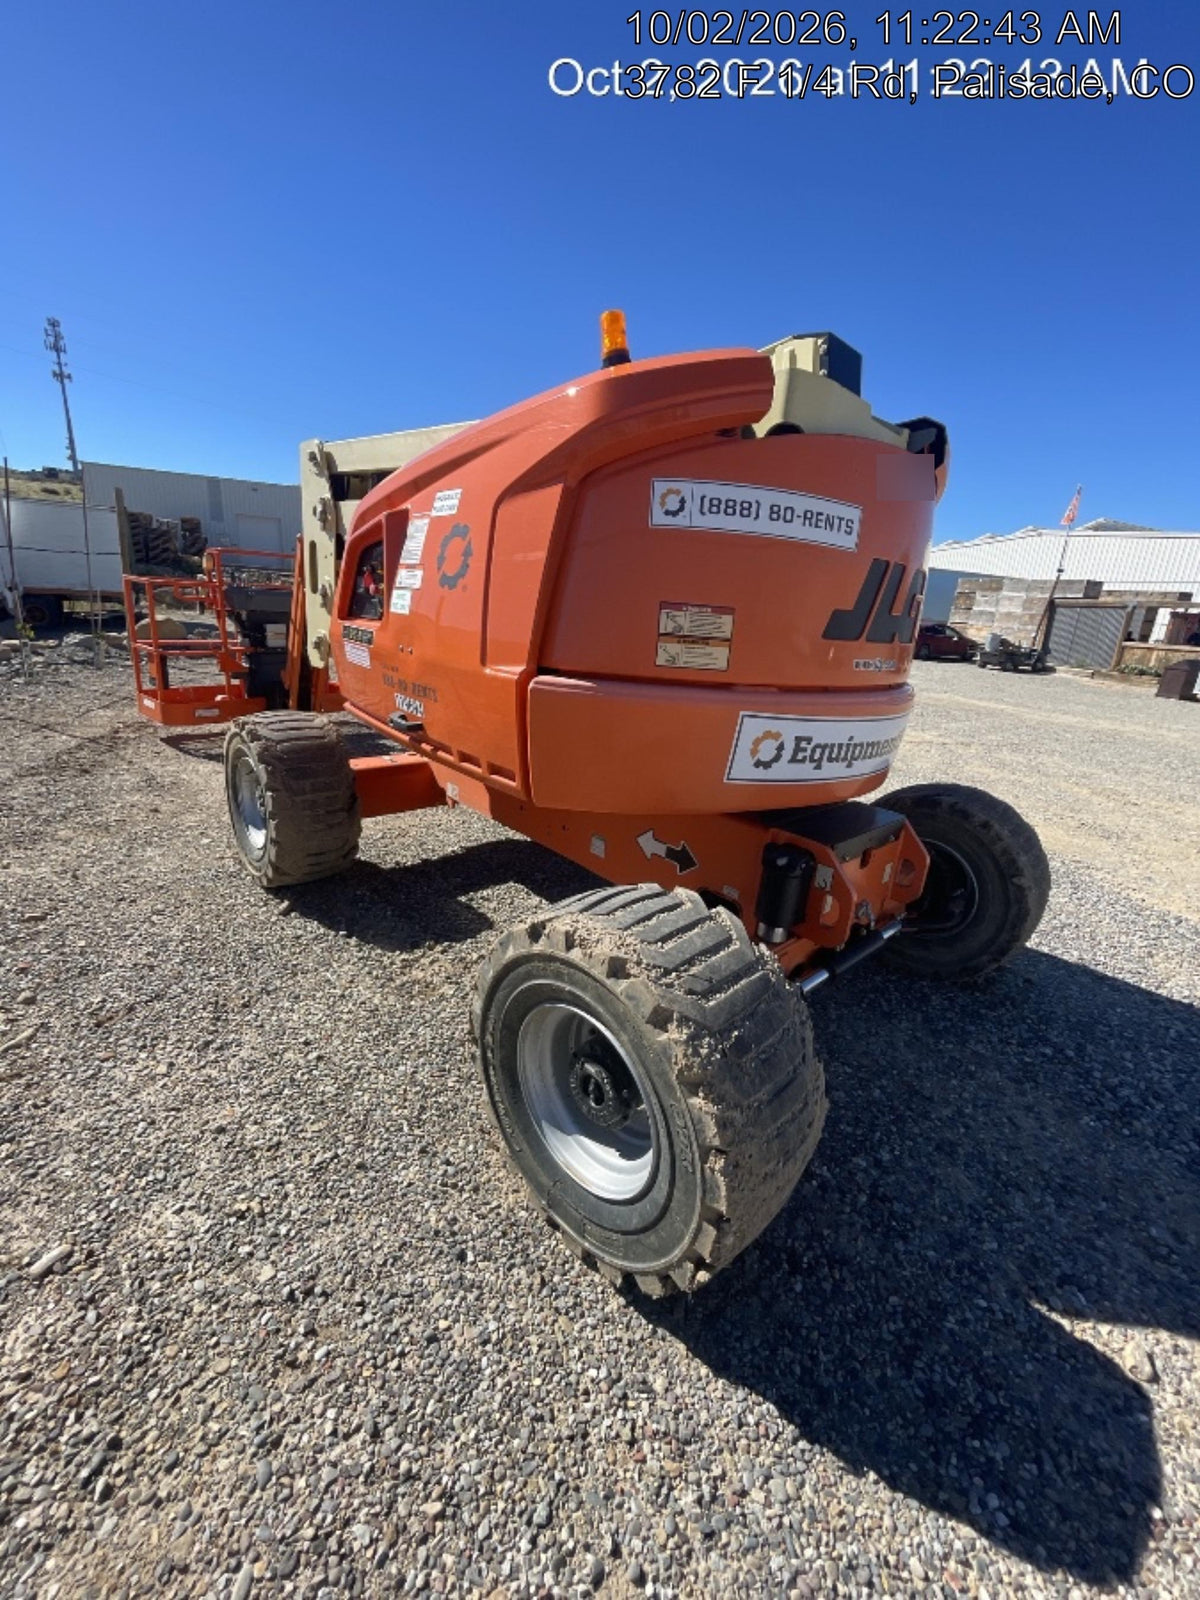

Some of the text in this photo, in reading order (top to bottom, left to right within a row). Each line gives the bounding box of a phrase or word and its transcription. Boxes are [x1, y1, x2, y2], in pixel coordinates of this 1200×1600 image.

[699, 495, 854, 536] (888) 80-RENTS
[787, 735, 902, 770] Equipmen
